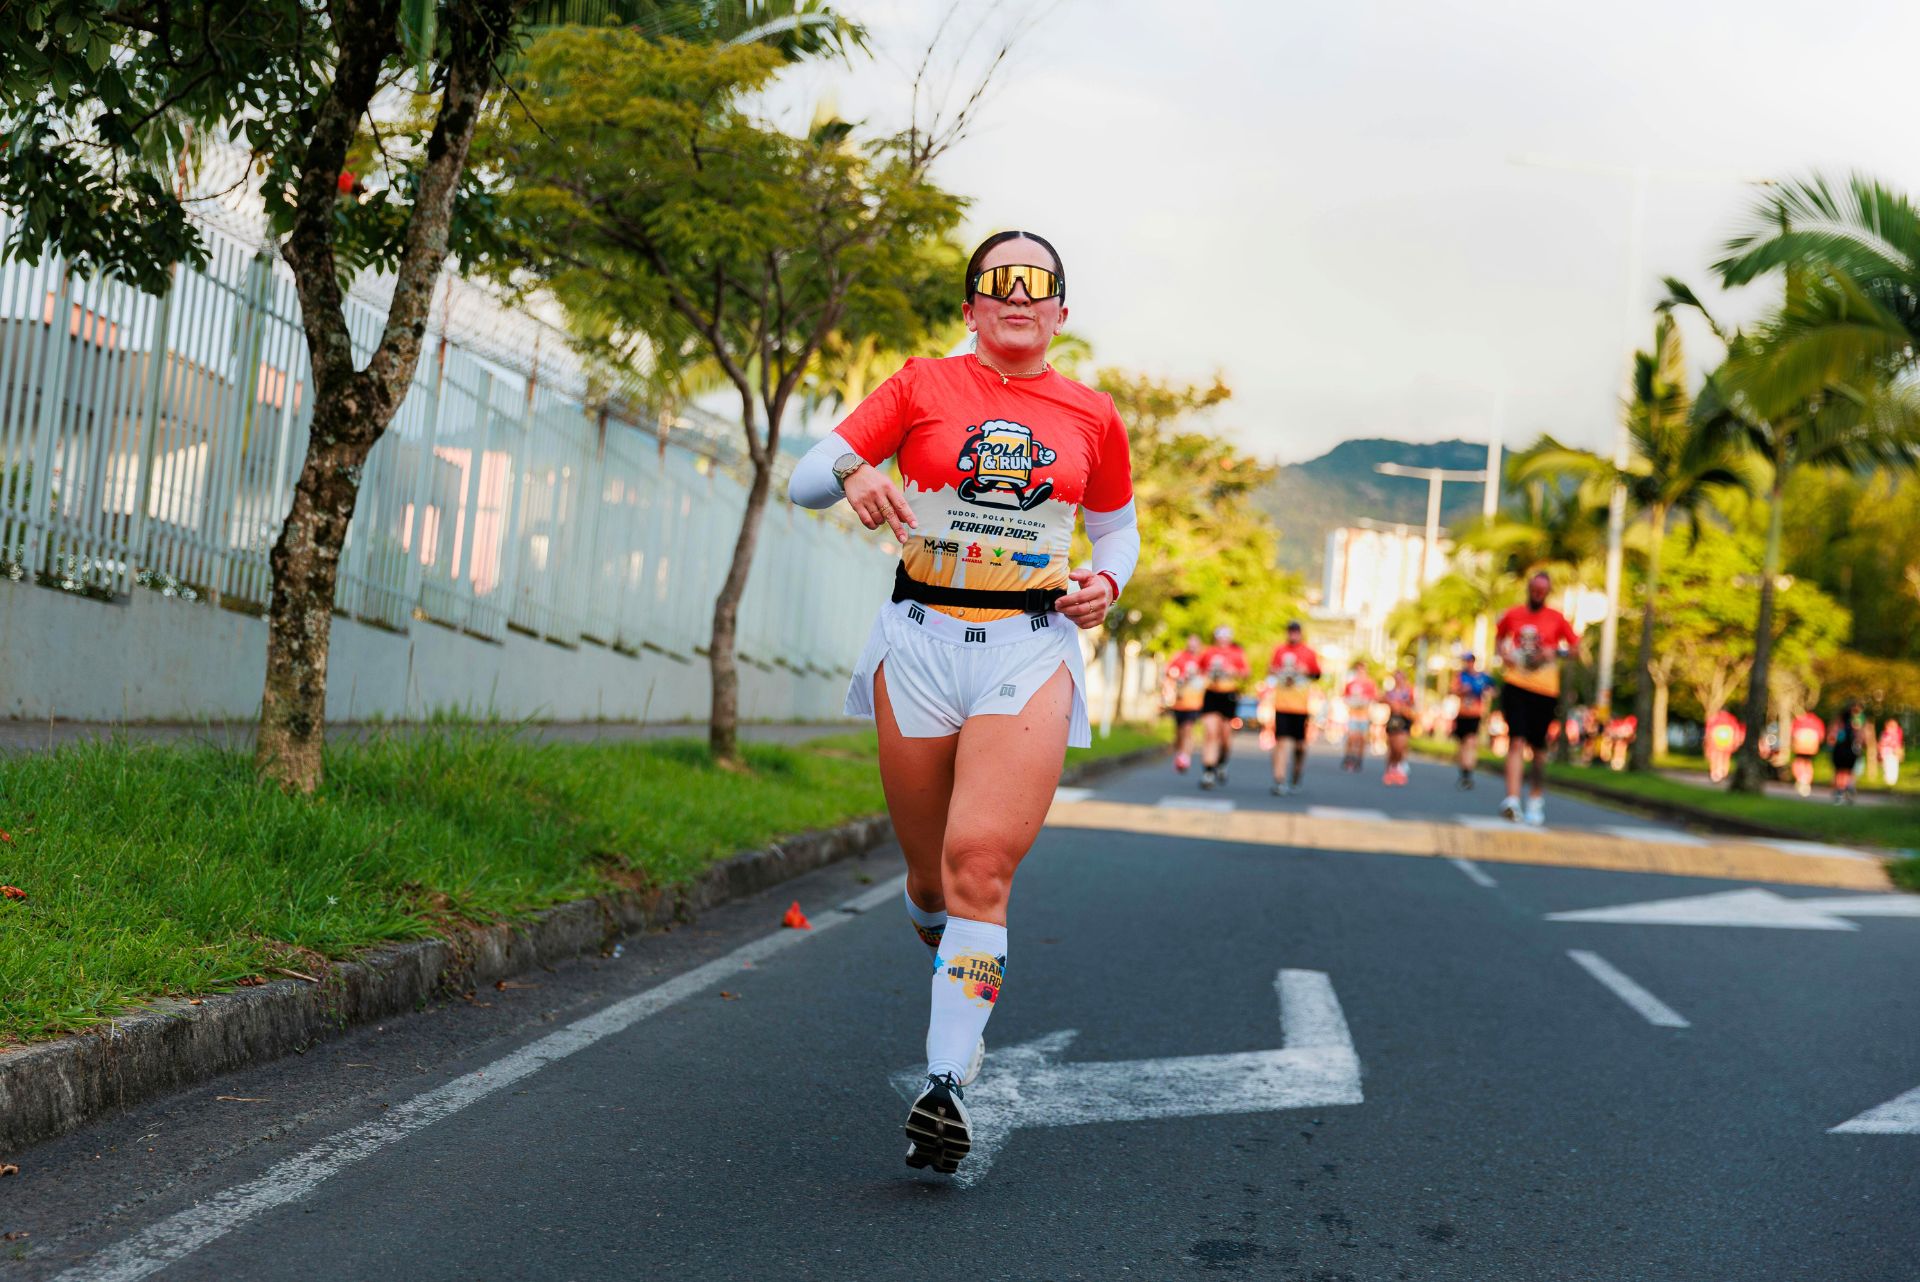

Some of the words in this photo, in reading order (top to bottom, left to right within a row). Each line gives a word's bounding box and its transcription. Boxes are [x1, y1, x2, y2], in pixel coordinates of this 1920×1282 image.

[977, 442, 1025, 457] POLA
[983, 455, 998, 470] &
[999, 456, 1033, 470] RUN
[947, 509, 979, 519] SUDOR,
[983, 514, 1004, 522] POLA
[1017, 519, 1045, 528] GLORIA
[950, 520, 1004, 536] PEREIRA
[1004, 527, 1039, 541] 2025
